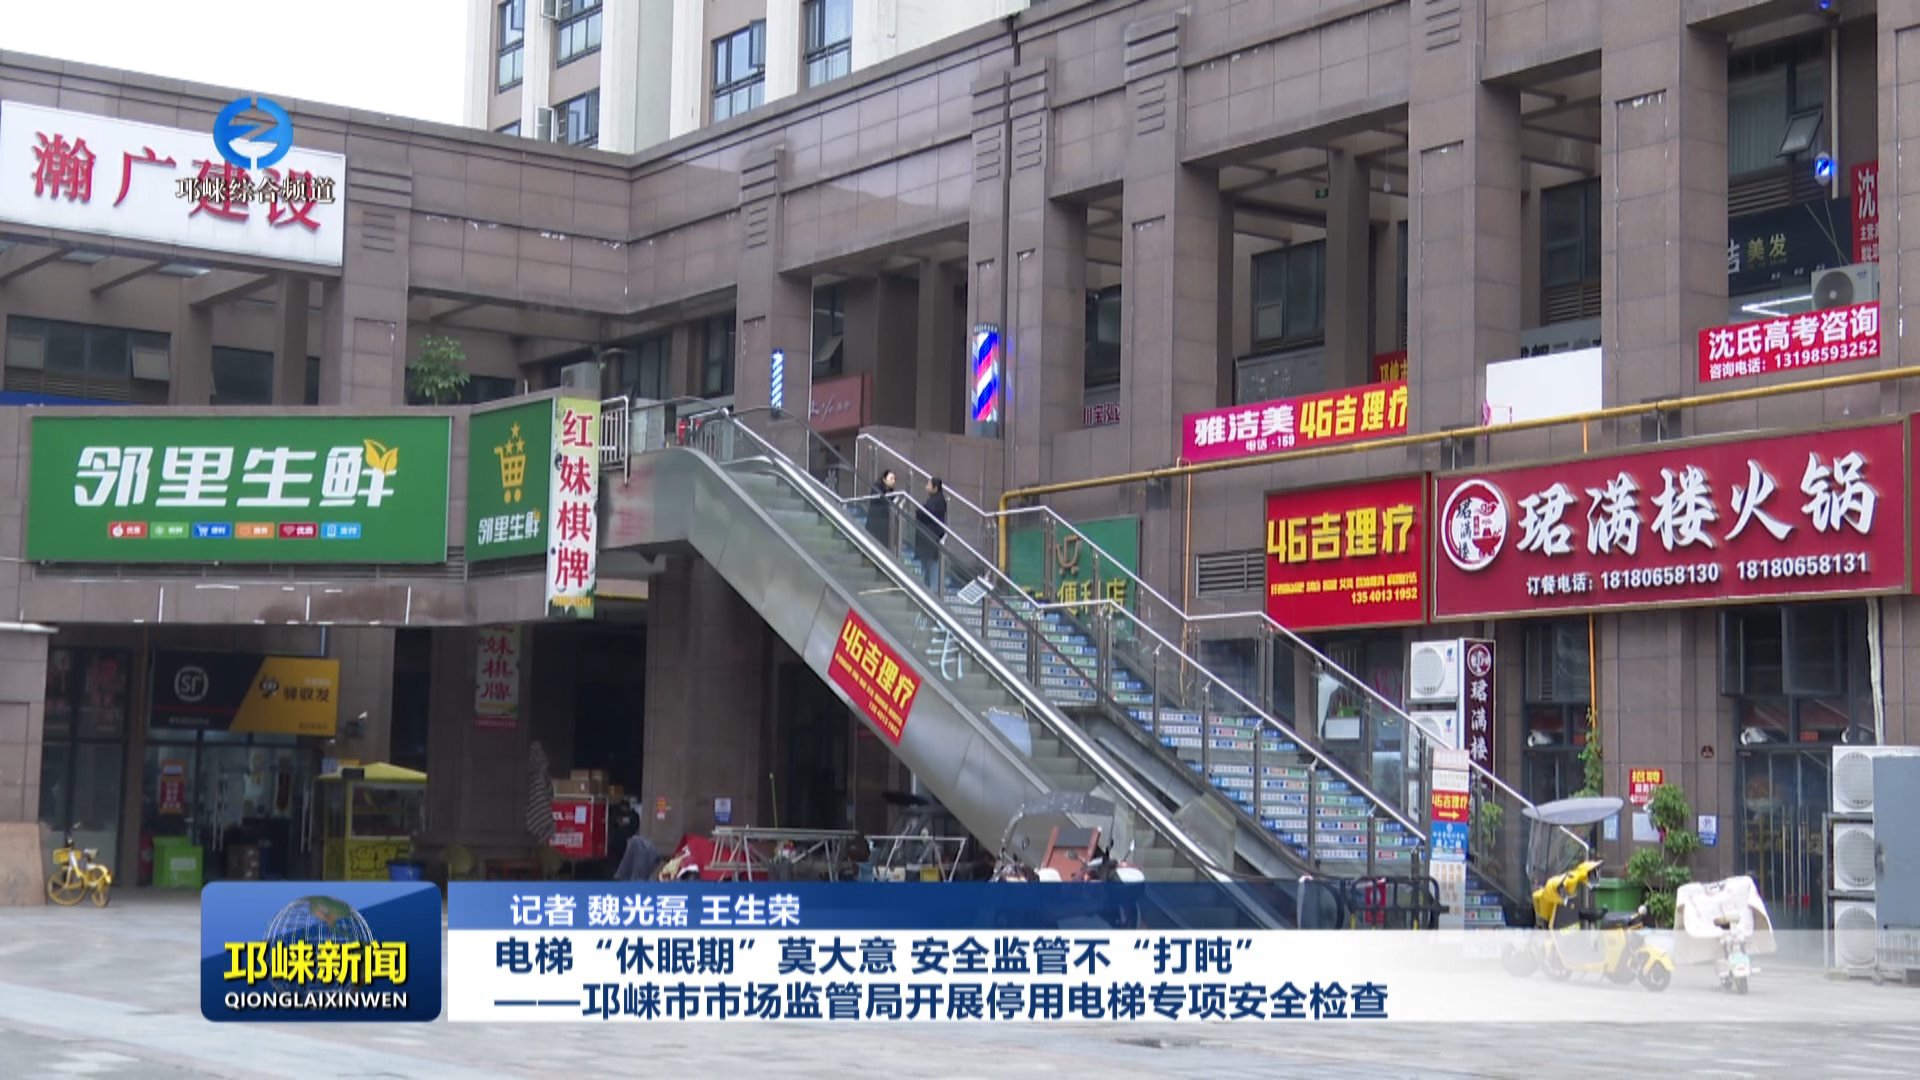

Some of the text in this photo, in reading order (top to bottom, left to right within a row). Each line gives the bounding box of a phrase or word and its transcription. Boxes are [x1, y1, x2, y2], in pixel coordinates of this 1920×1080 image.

[32, 131, 321, 231] 瀚广建设
[1858, 167, 1879, 219] 沈
[1747, 233, 1787, 262] 美发
[1709, 305, 1878, 361] 沈氏高考咨询
[1774, 339, 1878, 369] 13198593252
[1194, 385, 1408, 447] 雅洁美 46吉理疗
[74, 440, 398, 508] 邻里生鲜
[554, 409, 594, 588] 红妹棋牌
[1516, 450, 1879, 557] 珺满楼火锅
[477, 508, 541, 546] 邻里生鲜
[1267, 504, 1415, 563] 46吉理疗
[1600, 562, 1720, 590] 18180658130
[1736, 552, 1868, 580] 18180658131
[481, 624, 515, 701] 妹棋牌
[842, 619, 916, 710] 46吉理疗
